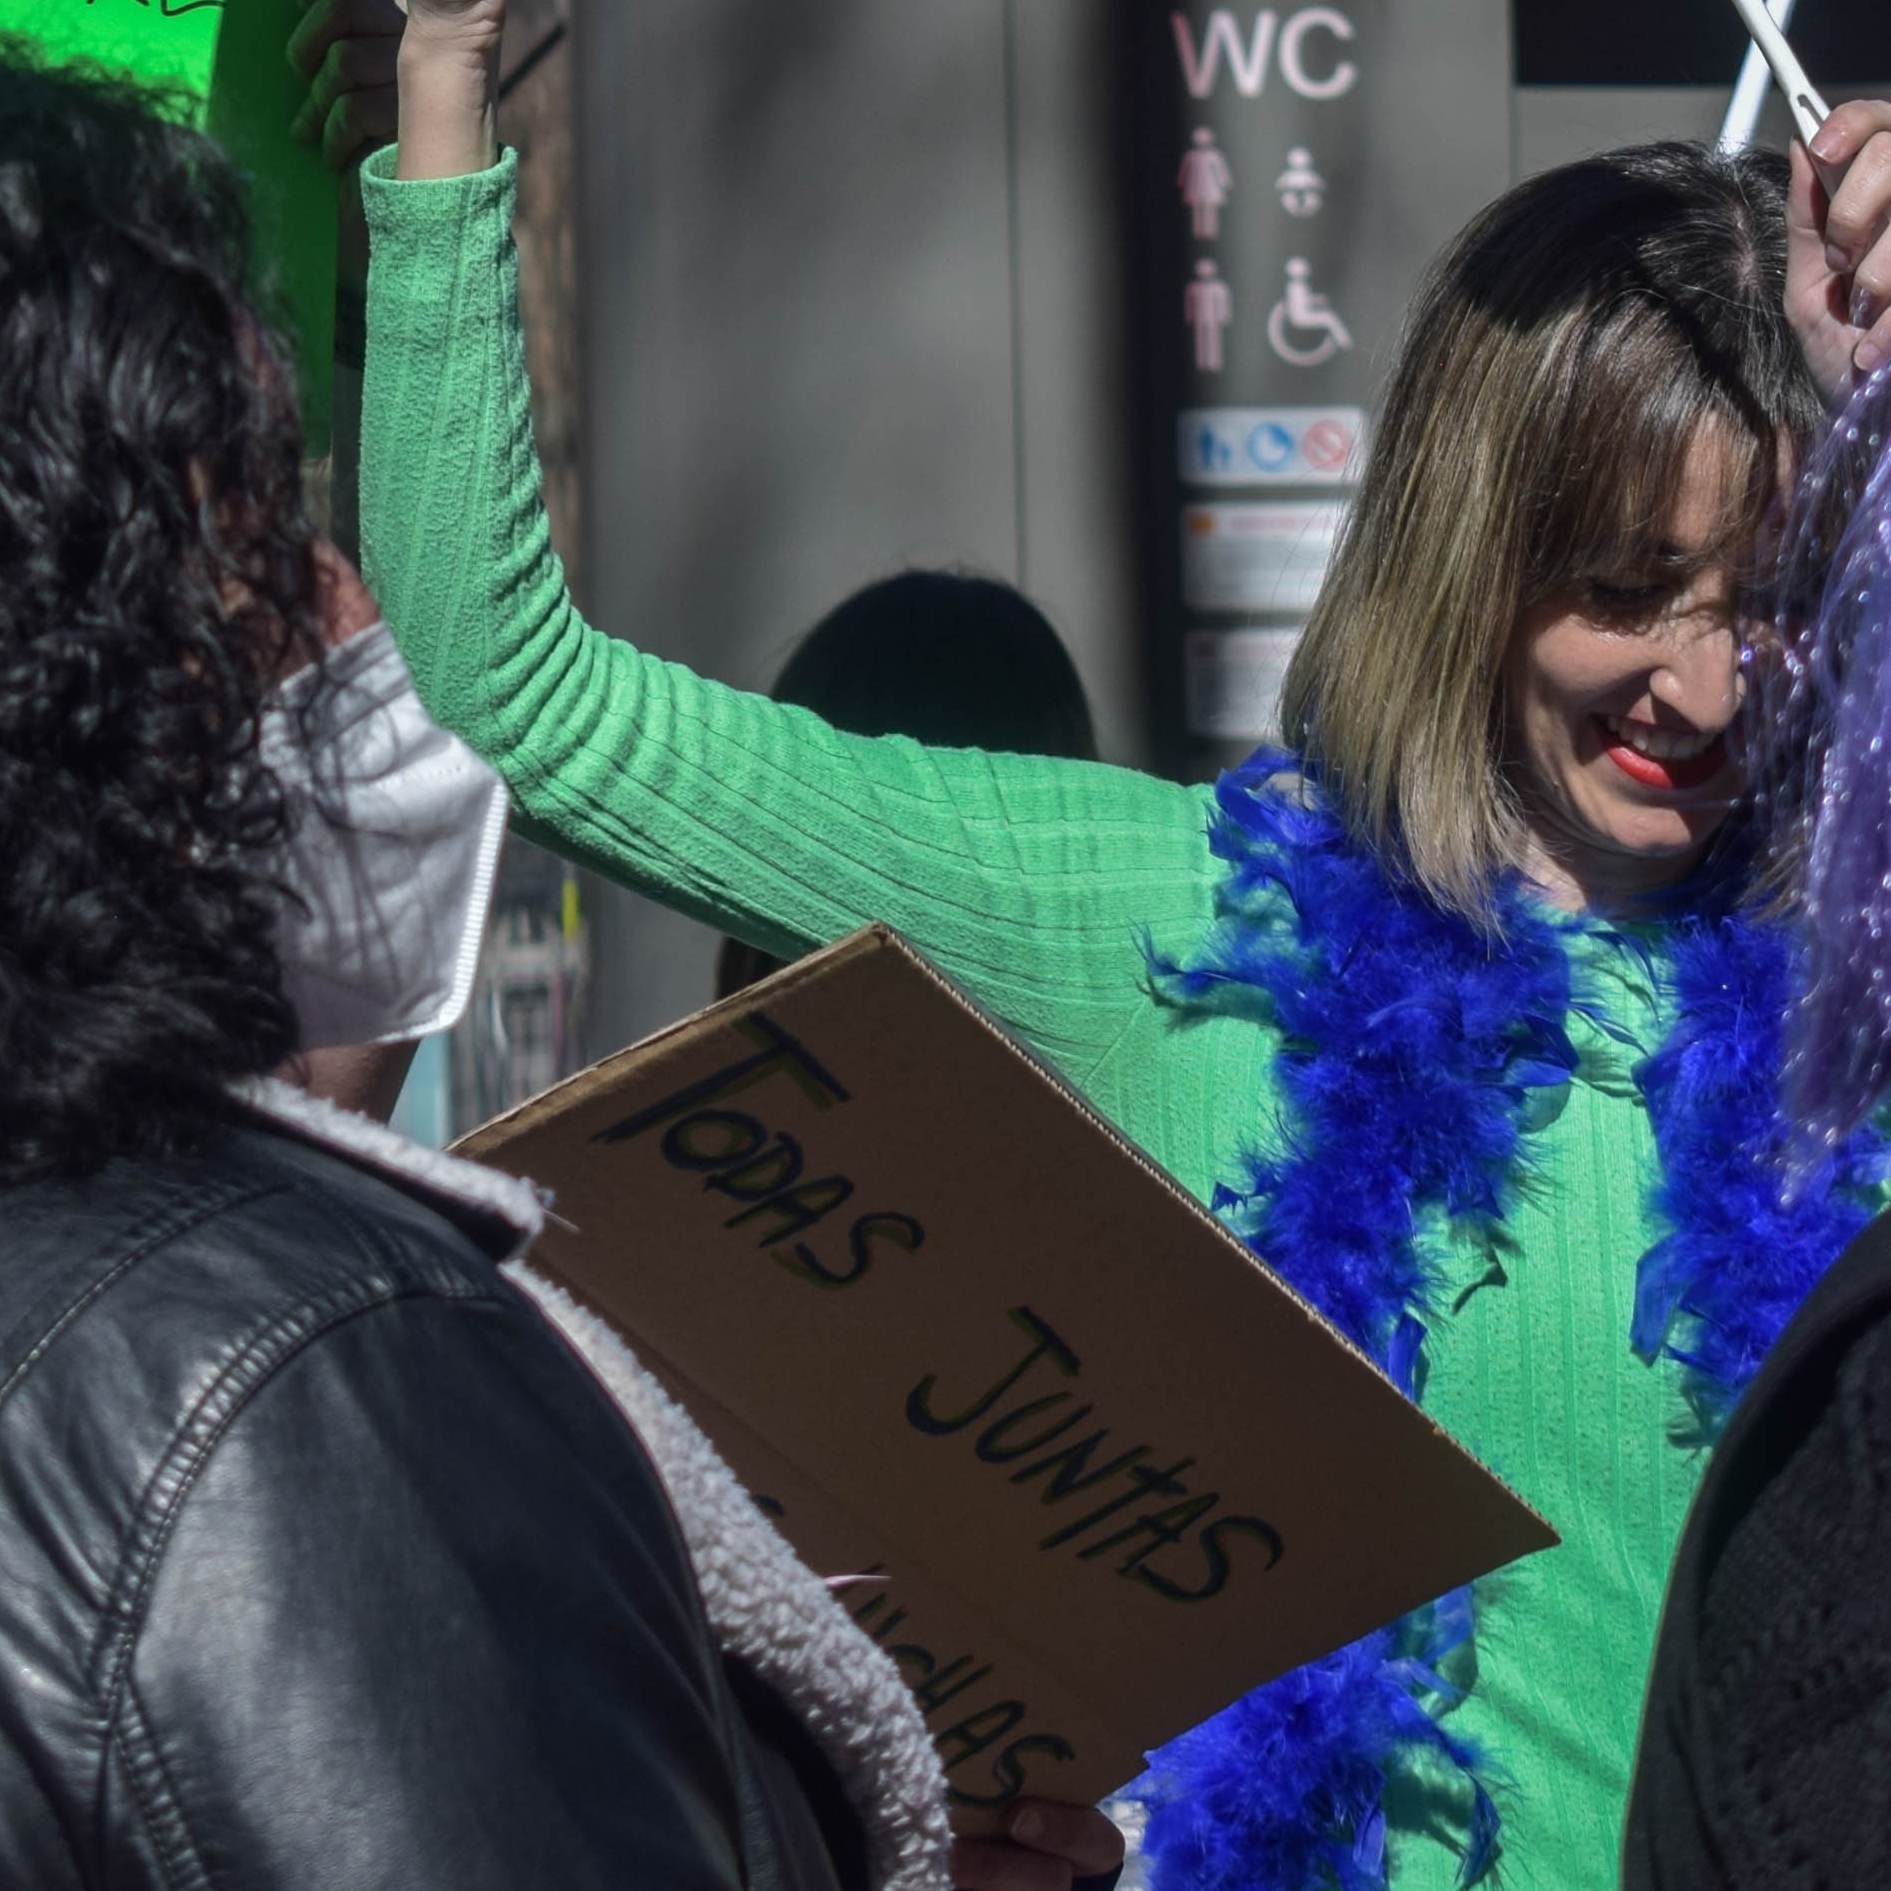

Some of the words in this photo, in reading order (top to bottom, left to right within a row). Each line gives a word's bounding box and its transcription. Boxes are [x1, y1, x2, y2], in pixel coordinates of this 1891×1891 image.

[1169, 6, 1356, 99] WC
[589, 1009, 926, 1290] TODAS
[904, 1305, 1285, 1603] JUNTAS
